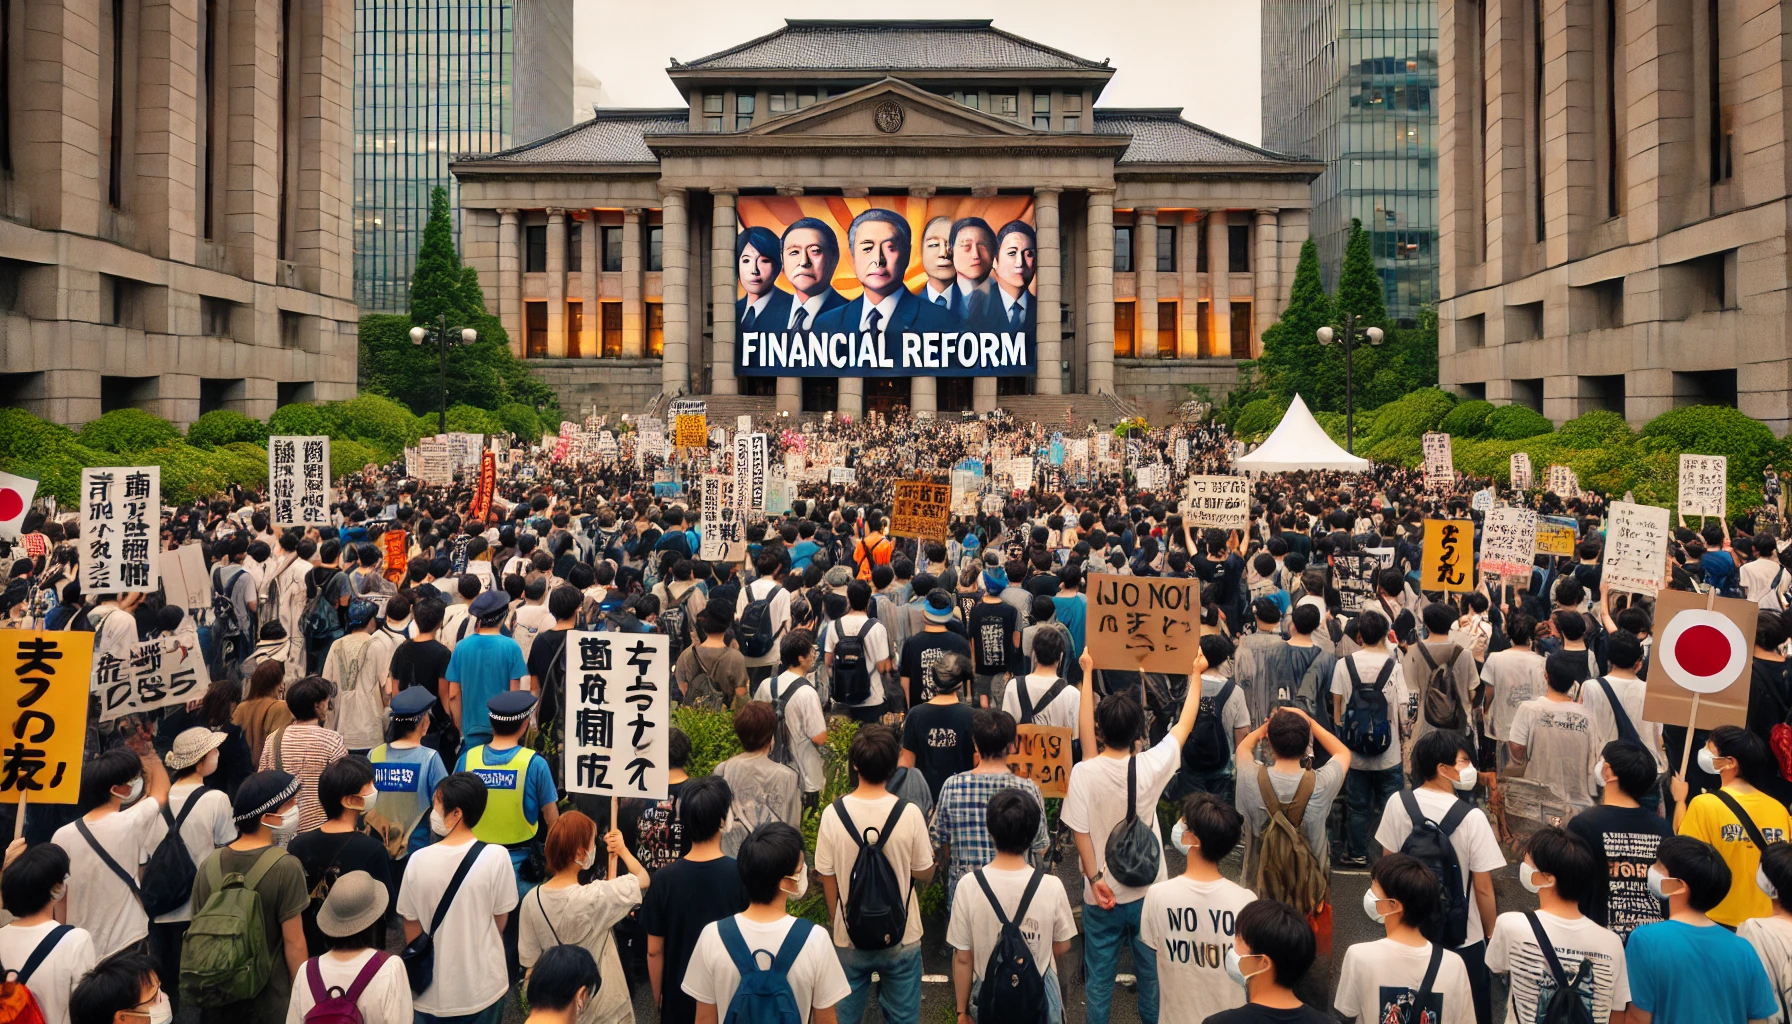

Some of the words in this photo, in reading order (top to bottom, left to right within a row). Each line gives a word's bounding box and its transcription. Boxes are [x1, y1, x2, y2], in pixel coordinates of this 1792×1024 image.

[742, 332, 894, 368] FINANCIAL
[902, 332, 1027, 368] REFORM
[1167, 907, 1198, 932] NO
